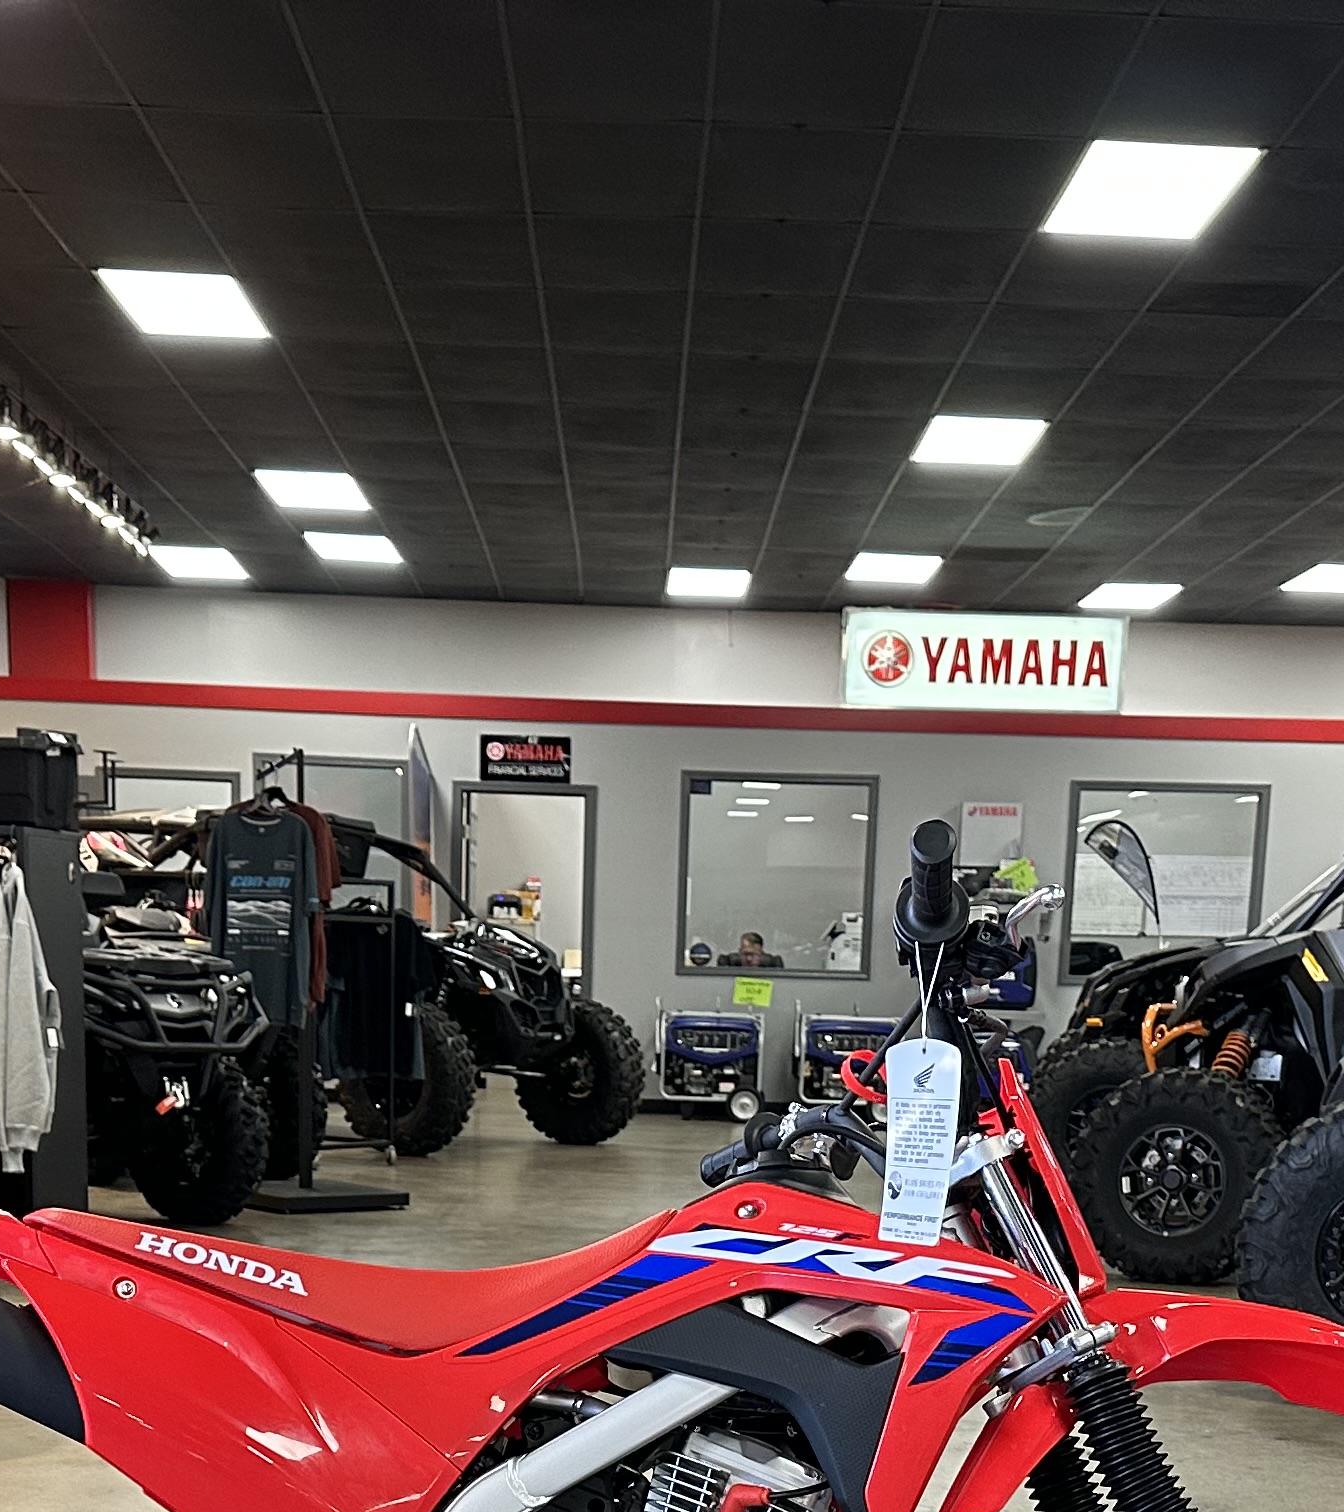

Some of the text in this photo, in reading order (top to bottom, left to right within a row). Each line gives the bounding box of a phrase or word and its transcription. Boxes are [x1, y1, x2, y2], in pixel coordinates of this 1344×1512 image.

[921, 637, 1108, 687] YAMAHA
[504, 743, 564, 761] YAMAHA
[134, 1231, 309, 1297] HONDA
[646, 1228, 1017, 1286] CRF
